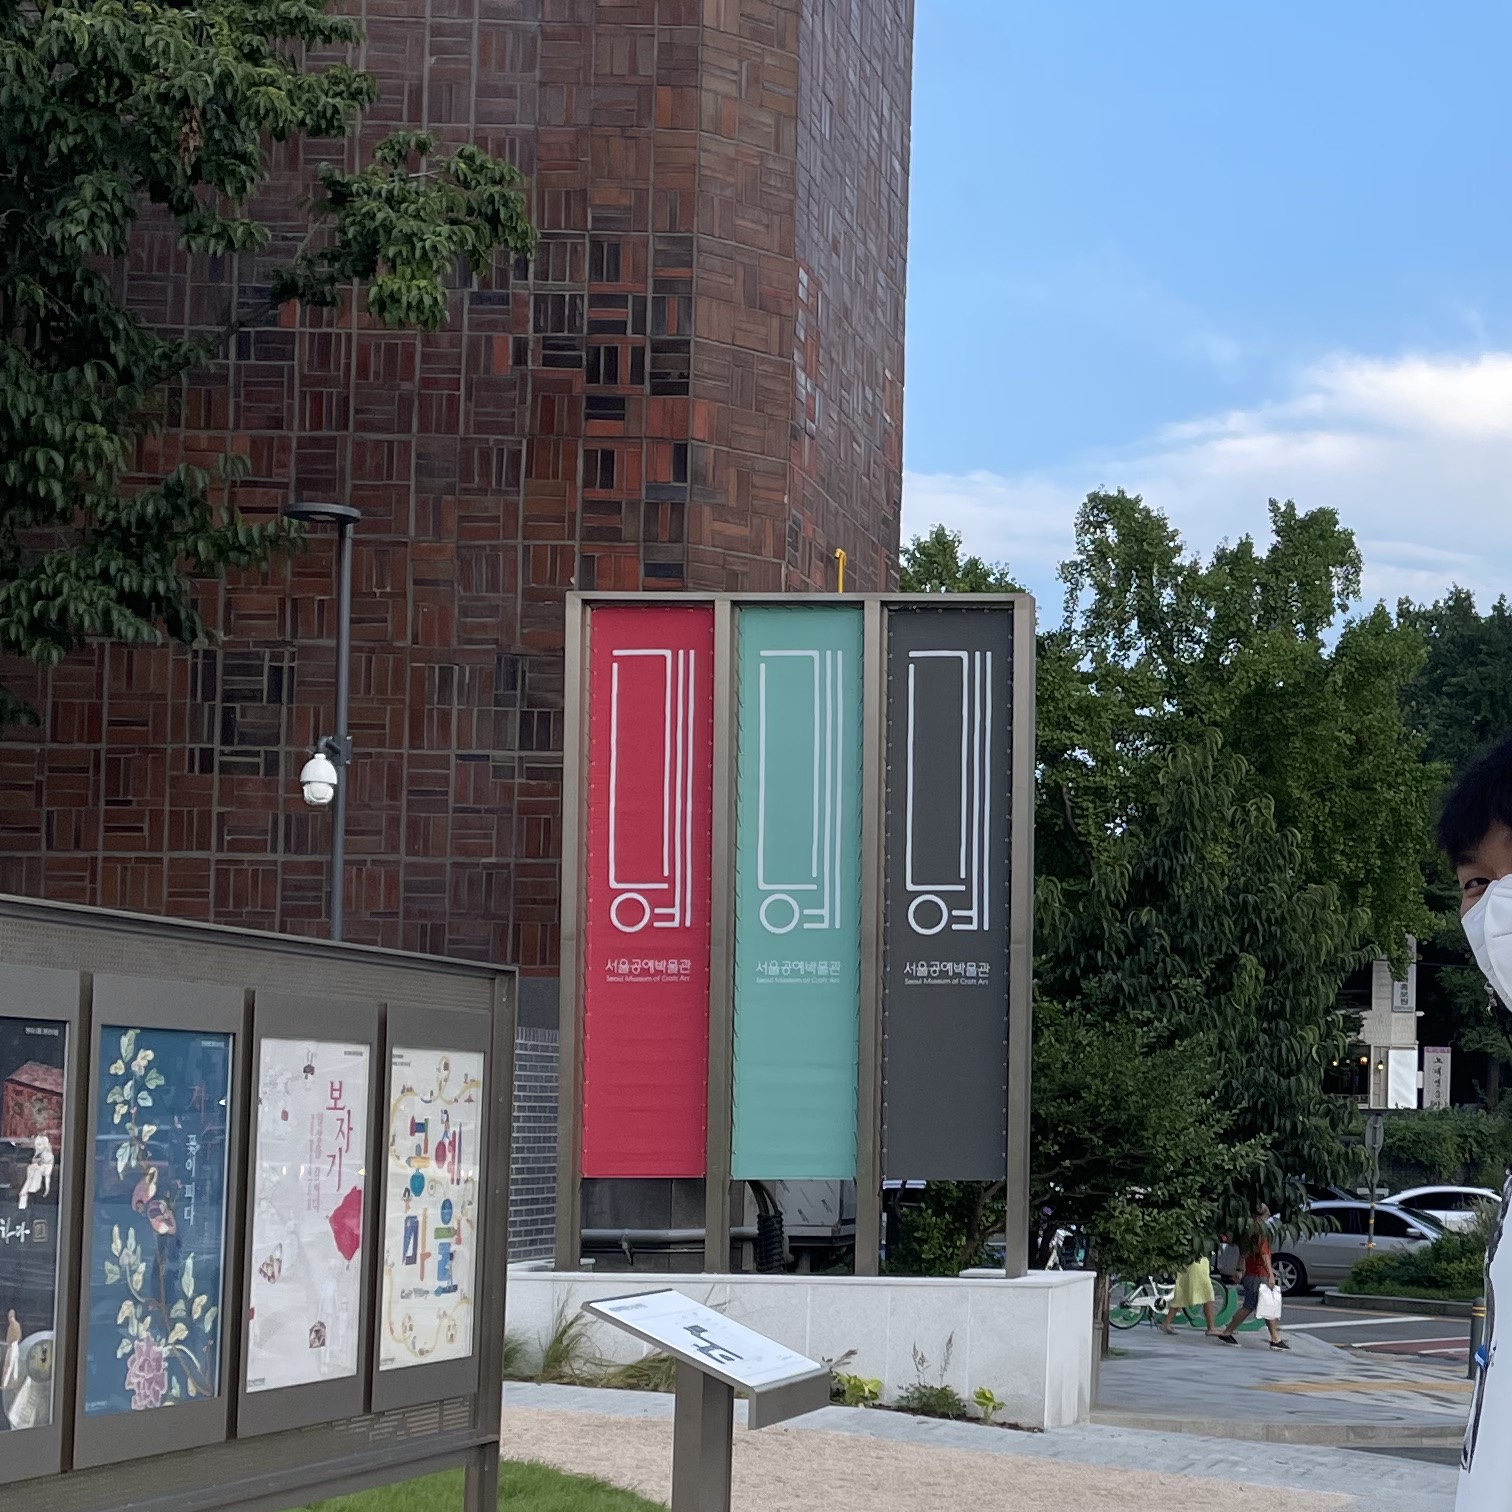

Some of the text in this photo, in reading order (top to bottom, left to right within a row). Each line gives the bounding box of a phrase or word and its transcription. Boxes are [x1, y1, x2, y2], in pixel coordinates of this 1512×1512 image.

[605, 959, 691, 974] 서울공예박물관
[756, 960, 841, 975] 서울공예박물관
[903, 961, 990, 977] 서울공예박물관
[326, 1081, 354, 1192] 보자기
